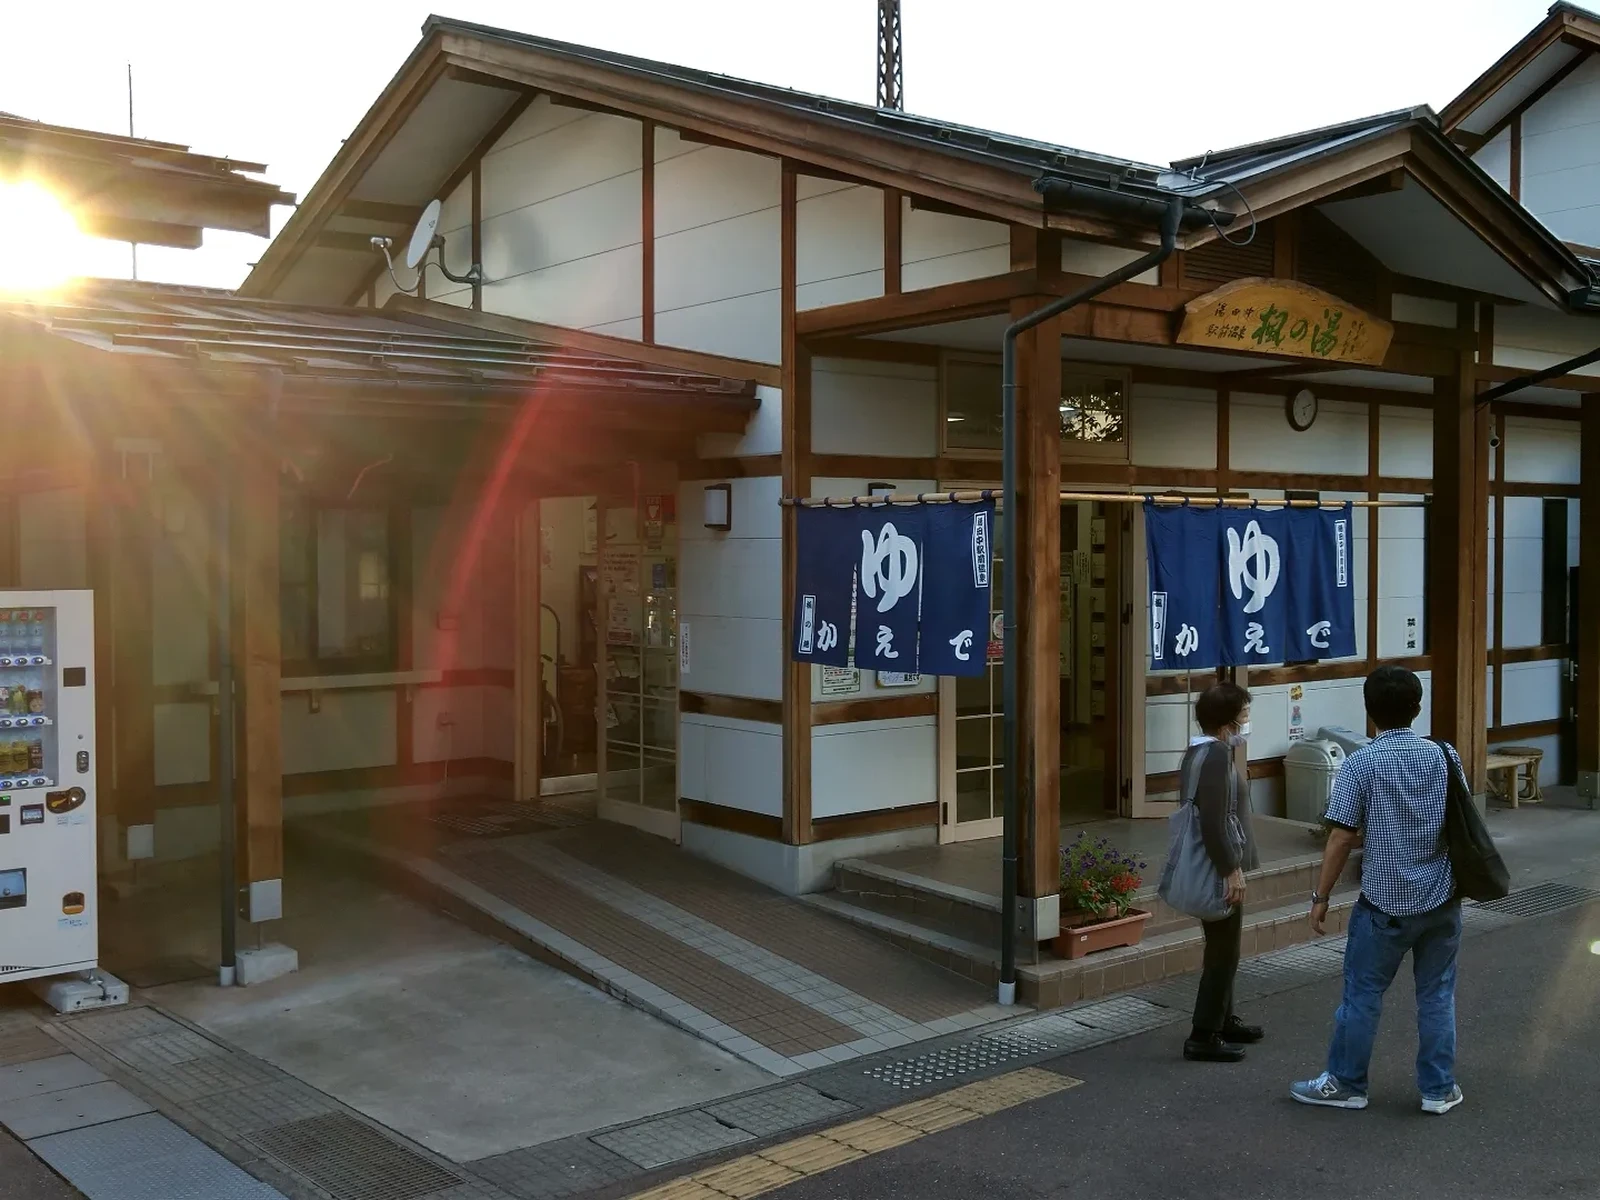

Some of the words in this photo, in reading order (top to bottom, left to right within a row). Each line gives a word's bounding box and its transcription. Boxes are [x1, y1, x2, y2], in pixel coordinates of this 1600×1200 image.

[1205, 323, 1247, 341] 駅前温泉
[1214, 302, 1254, 317] 湯田中
[1251, 303, 1343, 356] 楓の湯
[861, 522, 918, 613] ゆ
[1226, 520, 1281, 613] ゆ
